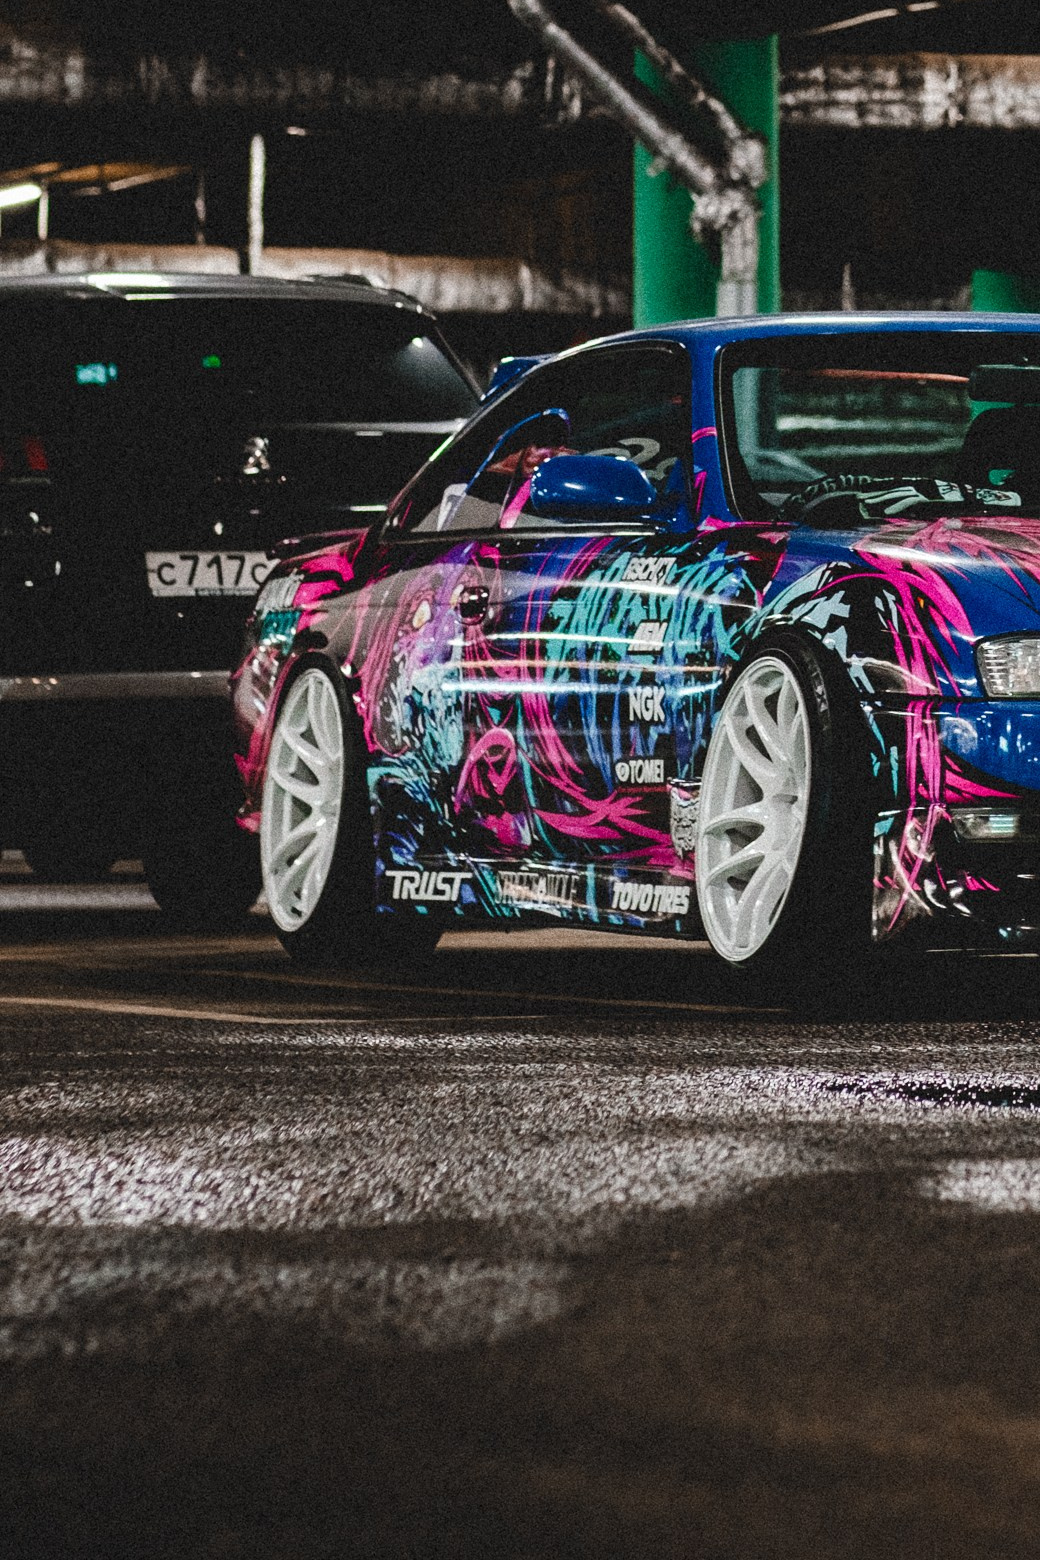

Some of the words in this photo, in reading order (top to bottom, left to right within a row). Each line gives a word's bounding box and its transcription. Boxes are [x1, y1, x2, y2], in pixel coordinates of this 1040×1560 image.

[628, 686, 665, 722] NGK
[629, 759, 664, 784] TOMEI
[385, 870, 473, 901] TRUST
